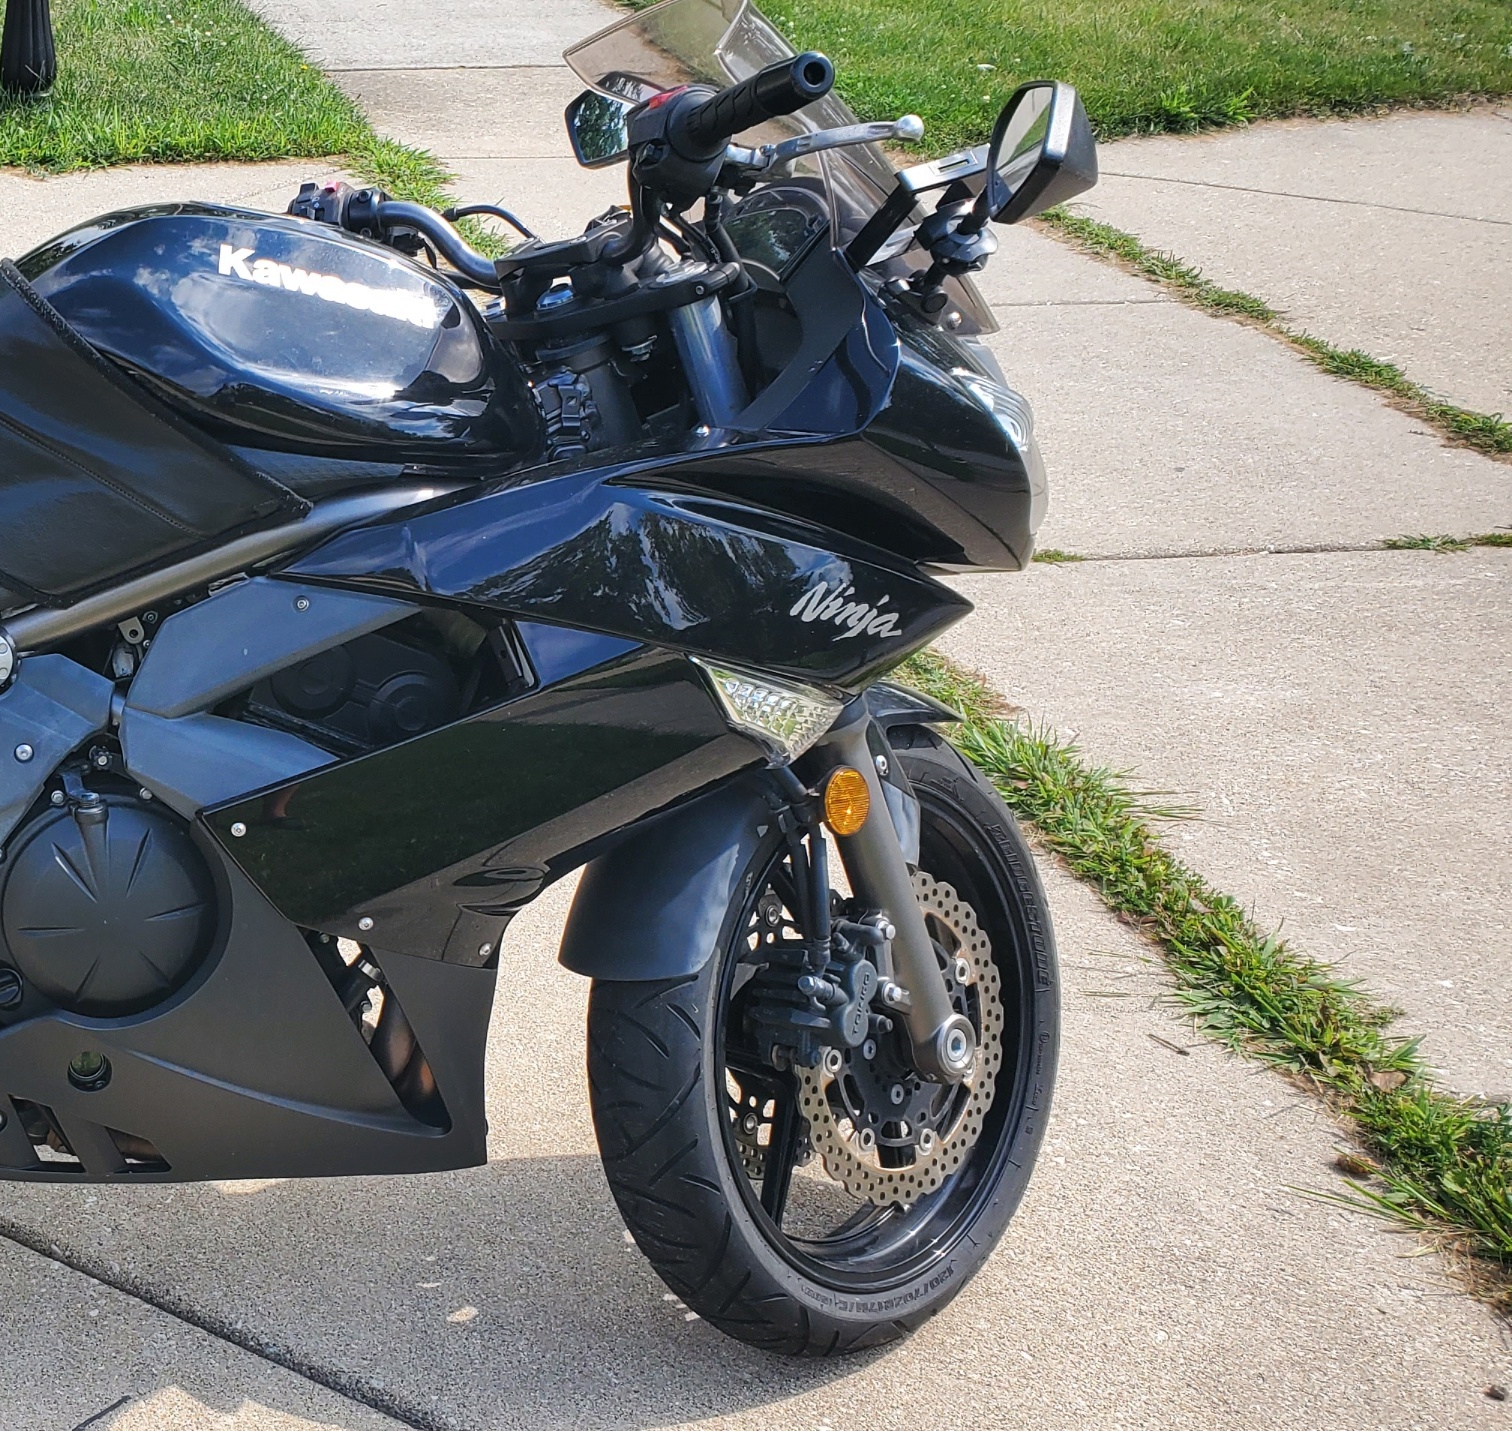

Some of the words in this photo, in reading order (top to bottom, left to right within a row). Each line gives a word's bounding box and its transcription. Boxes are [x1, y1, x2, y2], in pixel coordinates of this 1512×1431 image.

[218, 244, 435, 329] Kawi
[789, 580, 902, 642] Ninja
[989, 823, 1052, 985] BRIDGESTONE
[851, 971, 871, 1036] TOKICO
